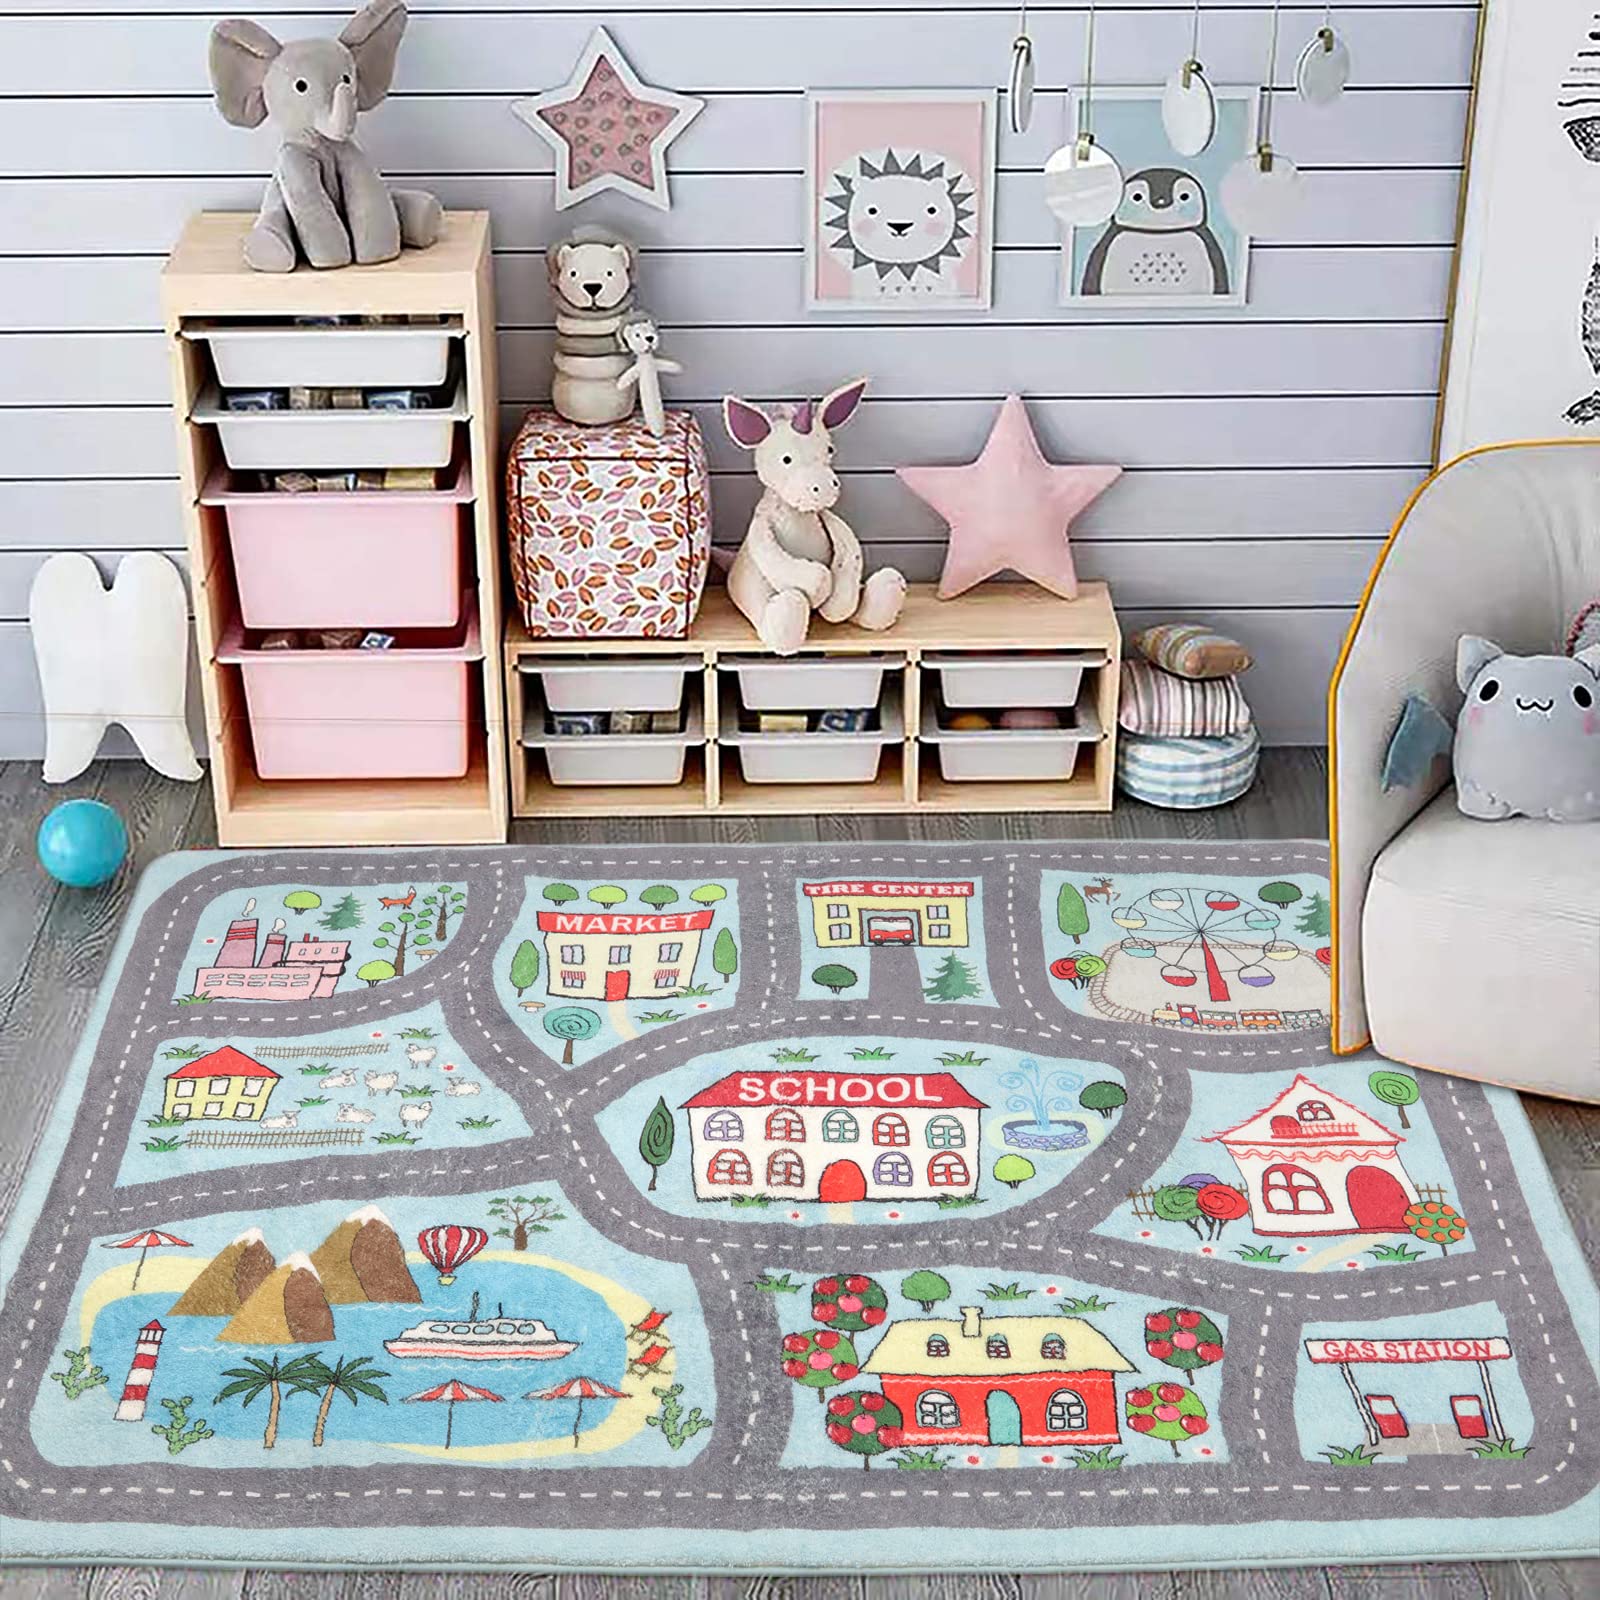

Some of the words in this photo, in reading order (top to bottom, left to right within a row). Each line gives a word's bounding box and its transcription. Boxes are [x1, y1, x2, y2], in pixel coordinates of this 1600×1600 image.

[805, 884, 865, 895] TIRE
[871, 884, 970, 895] CENTER
[555, 913, 698, 932] MARKET
[738, 1076, 943, 1102] SCHOOL
[1323, 1341, 1377, 1358] GAS
[1384, 1340, 1491, 1359] STATION
